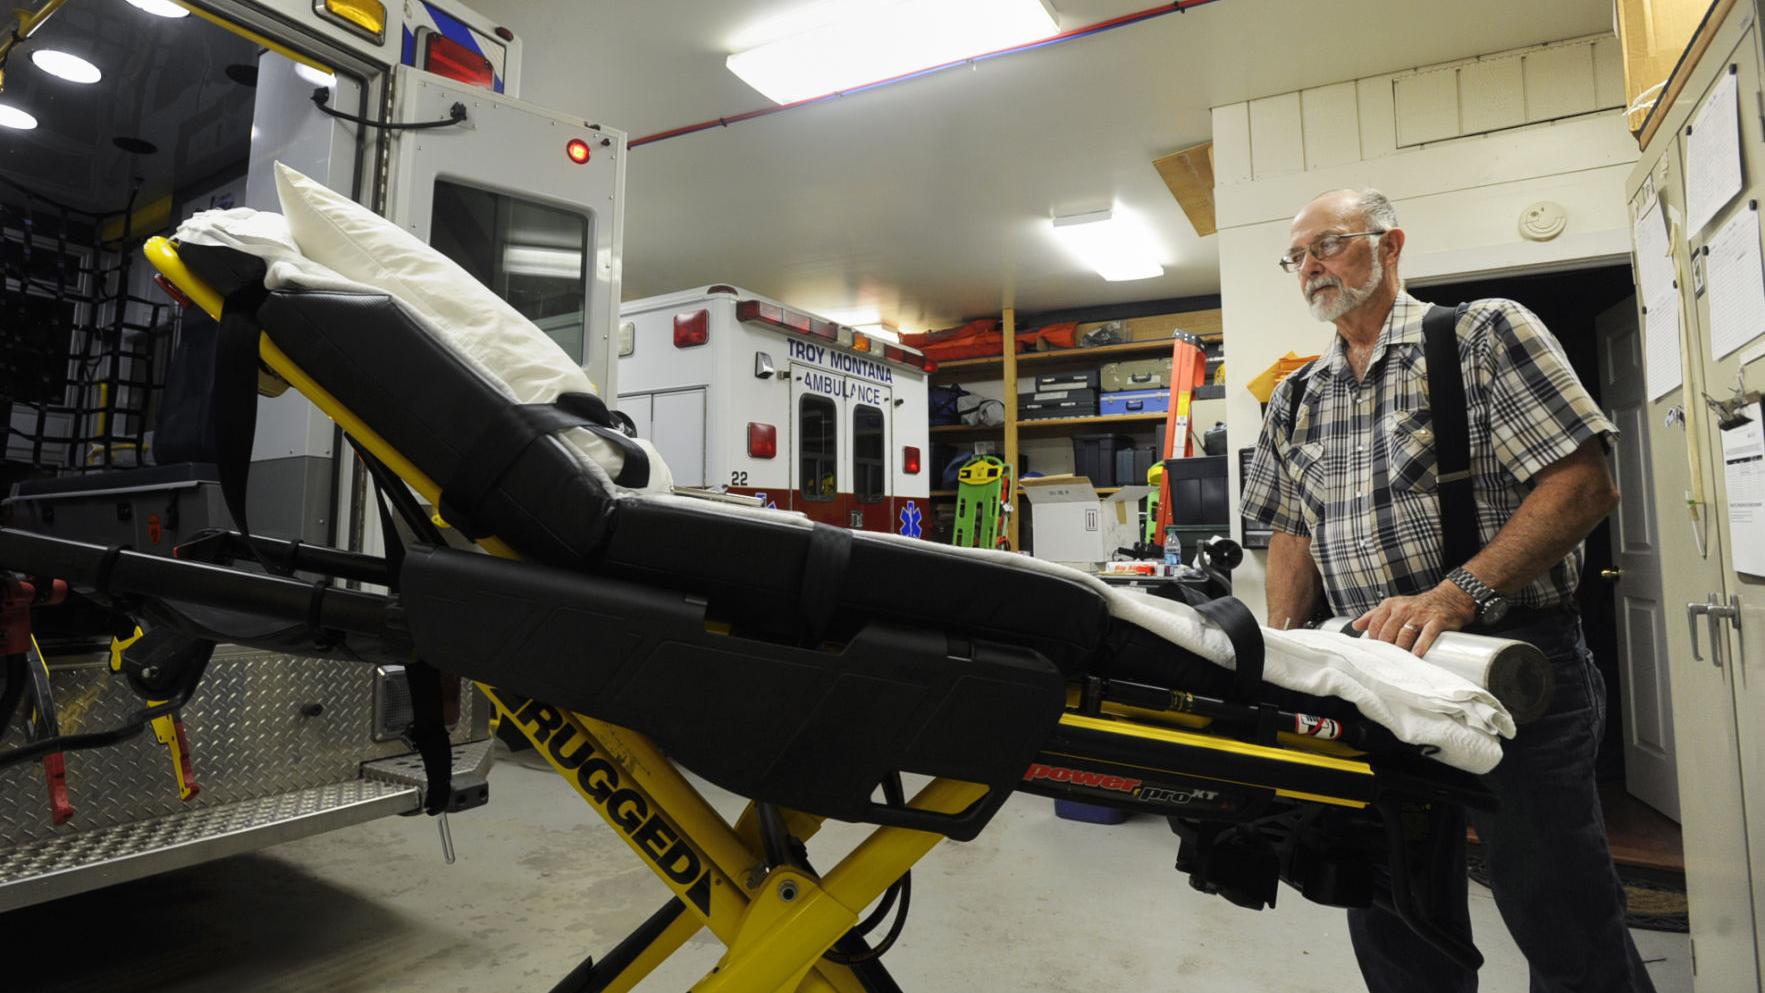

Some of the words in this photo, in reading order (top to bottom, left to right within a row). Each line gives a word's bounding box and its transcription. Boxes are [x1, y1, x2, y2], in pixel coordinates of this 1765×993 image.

[787, 338, 825, 364] TROY
[830, 351, 893, 384] MONTANA
[804, 372, 880, 405] AMBULANCE
[731, 471, 748, 486] 22
[516, 700, 701, 885] RUGGED
[1023, 763, 1142, 792] power
